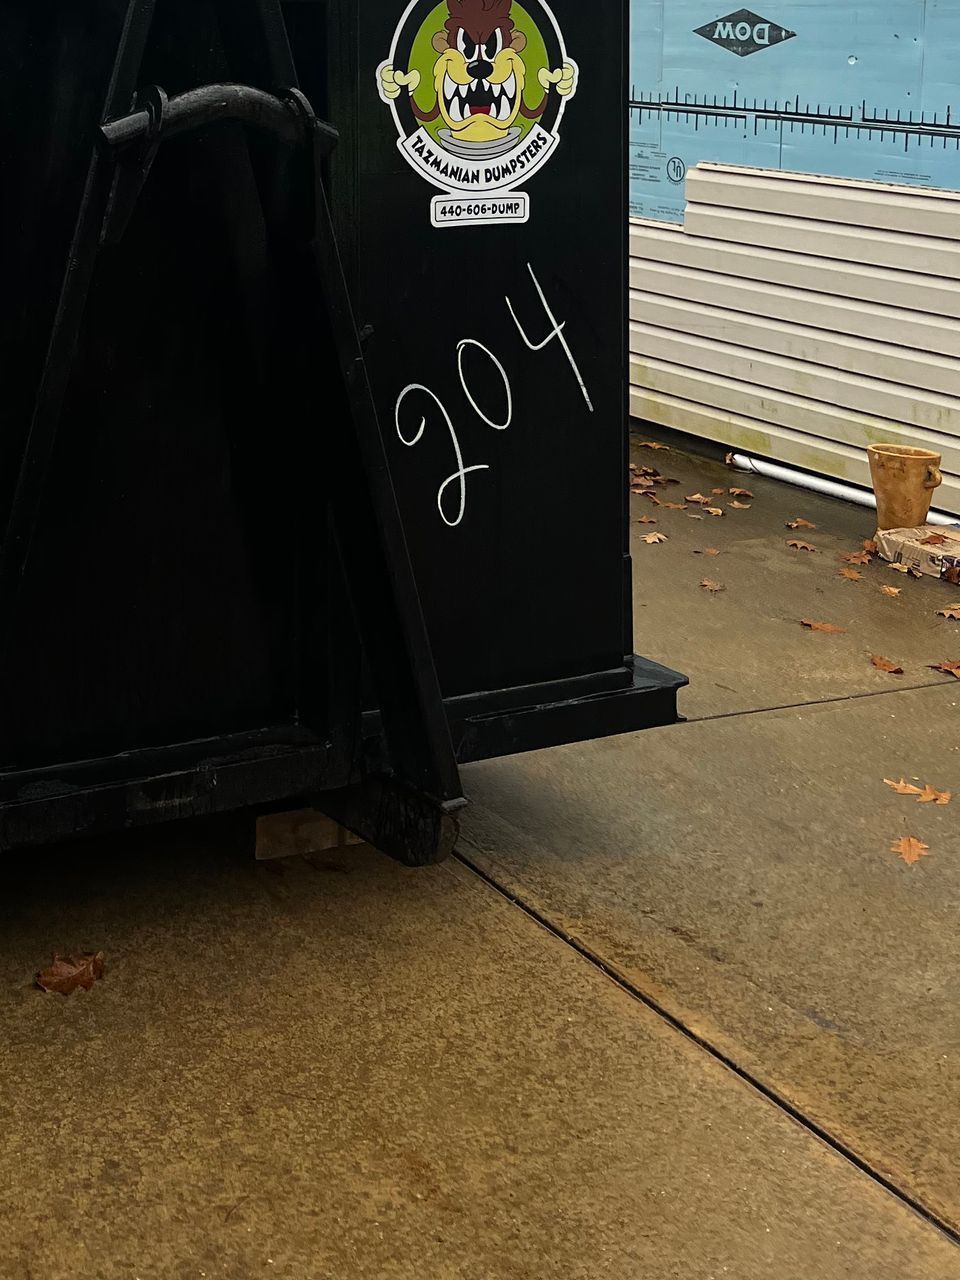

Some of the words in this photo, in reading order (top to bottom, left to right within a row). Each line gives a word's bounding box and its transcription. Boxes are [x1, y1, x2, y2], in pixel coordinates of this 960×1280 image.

[713, 21, 771, 45] DOW
[411, 135, 480, 184] TAZMANIAN
[485, 132, 548, 184] DUMPSTERS
[440, 202, 520, 217] 440-606-DUMP
[395, 261, 594, 527] 204
